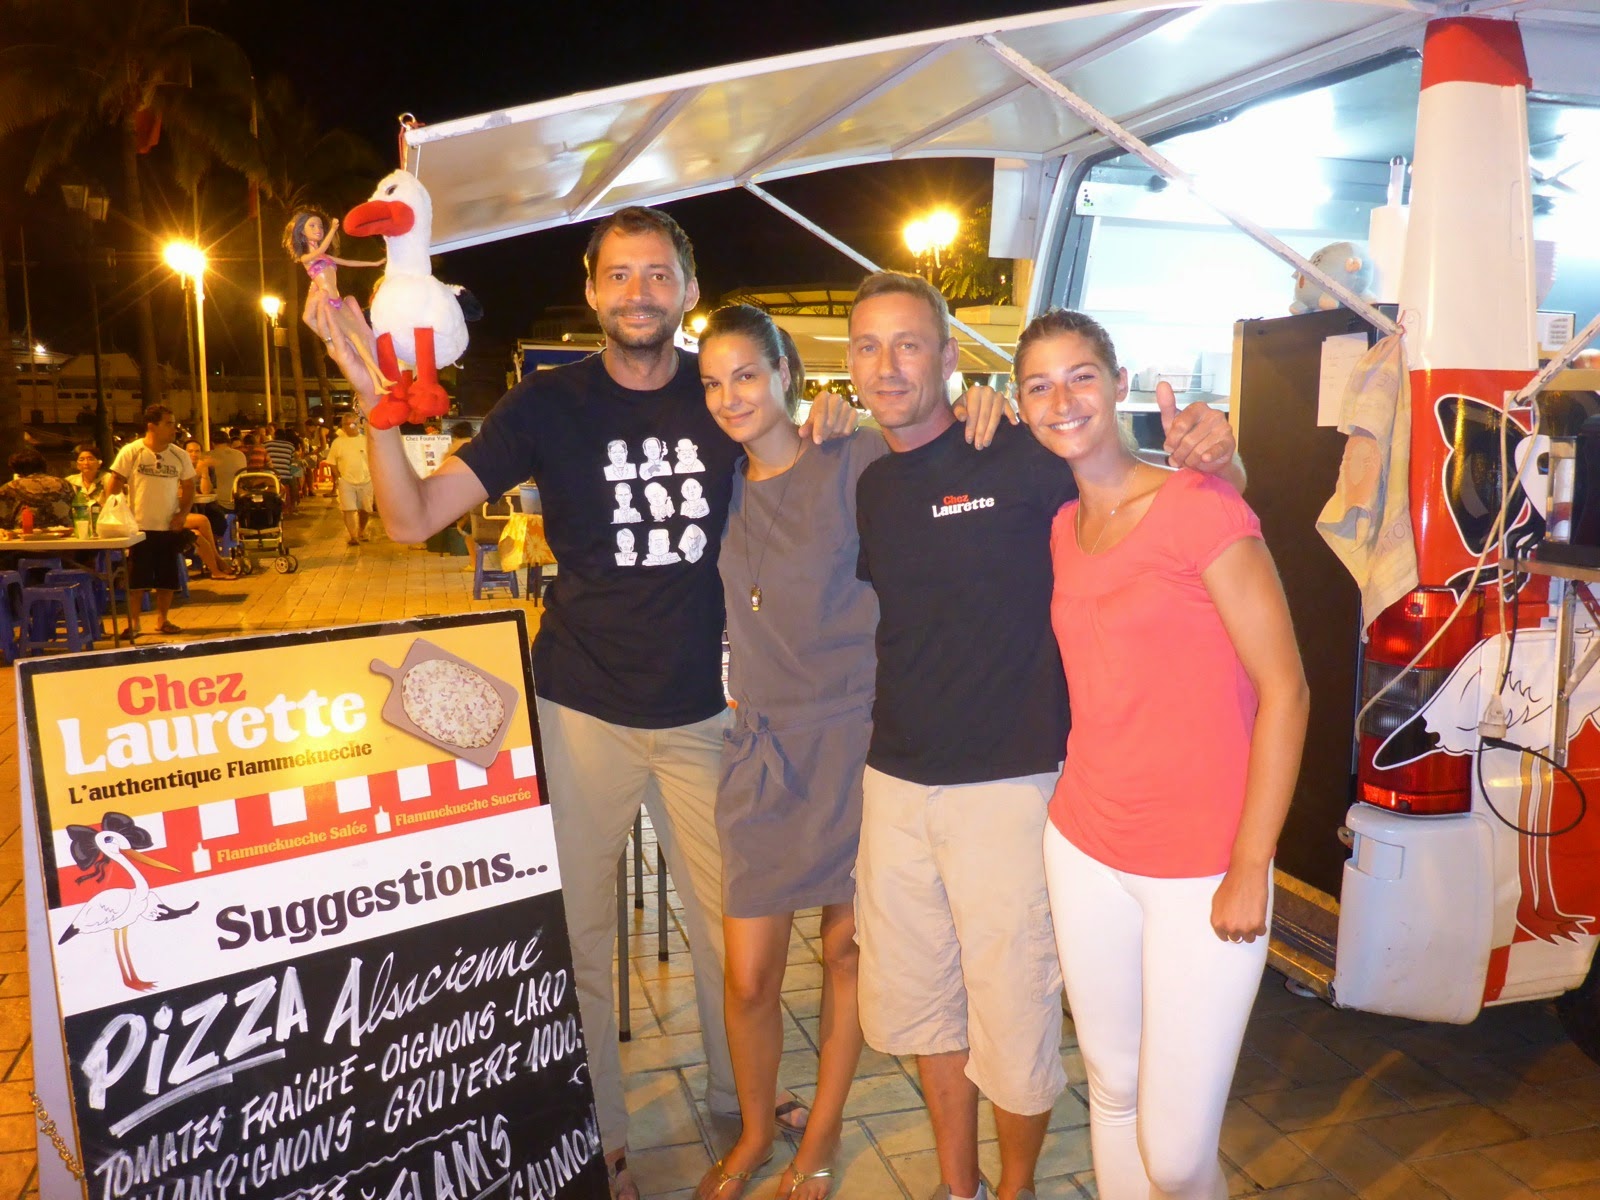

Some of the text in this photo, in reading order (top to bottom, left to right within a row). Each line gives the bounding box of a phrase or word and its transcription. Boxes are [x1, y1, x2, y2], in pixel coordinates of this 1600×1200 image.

[932, 497, 995, 517] Laurette
[943, 495, 969, 505] Chez
[117, 672, 248, 717] Chez
[56, 689, 368, 776] Laurette
[68, 741, 373, 805] L'authentique Flammekueche
[394, 788, 532, 827] Flammekueche Sucrée
[216, 821, 368, 863] Flammekueche Salée
[215, 852, 548, 950] Suggestions...
[323, 933, 543, 1047] Alsacienne
[383, 1041, 522, 1134] GRUYERE
[94, 1106, 227, 1200] TOMATES
